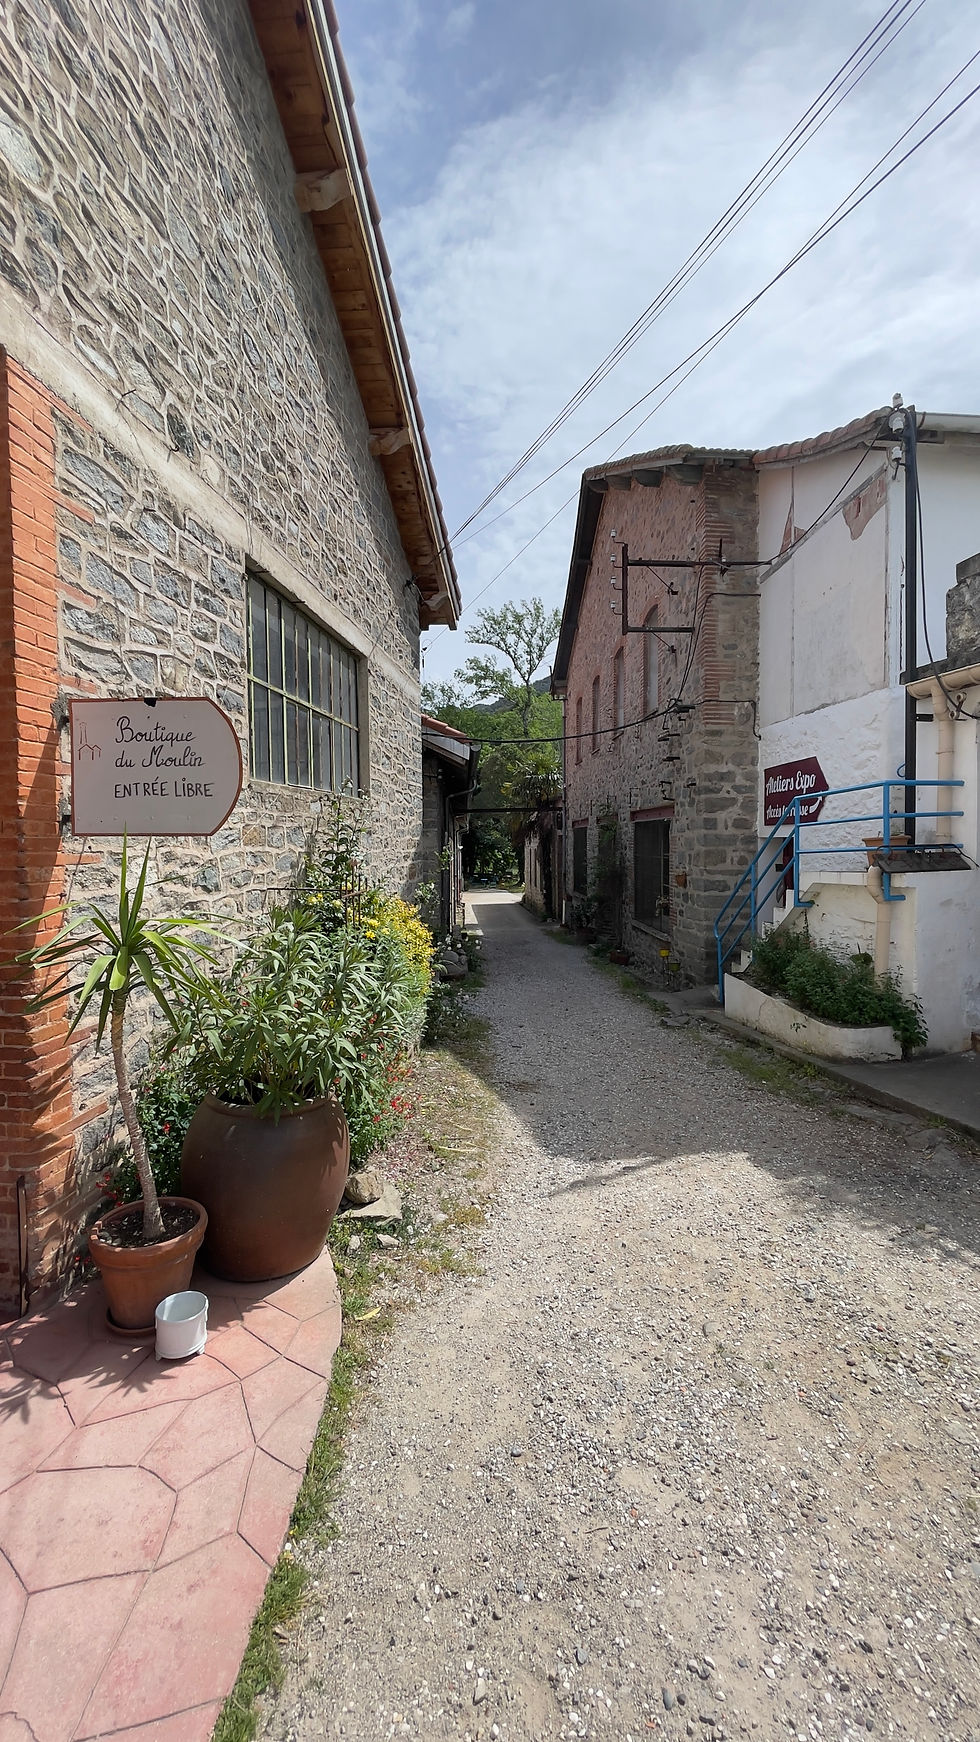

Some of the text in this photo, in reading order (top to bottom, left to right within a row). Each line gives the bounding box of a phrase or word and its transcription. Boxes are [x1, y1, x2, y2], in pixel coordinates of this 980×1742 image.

[115, 716, 196, 747] Boutique
[115, 744, 205, 768] du Moulin
[114, 776, 168, 798] ENTRÉE
[766, 771, 816, 796] Ateliers Expo
